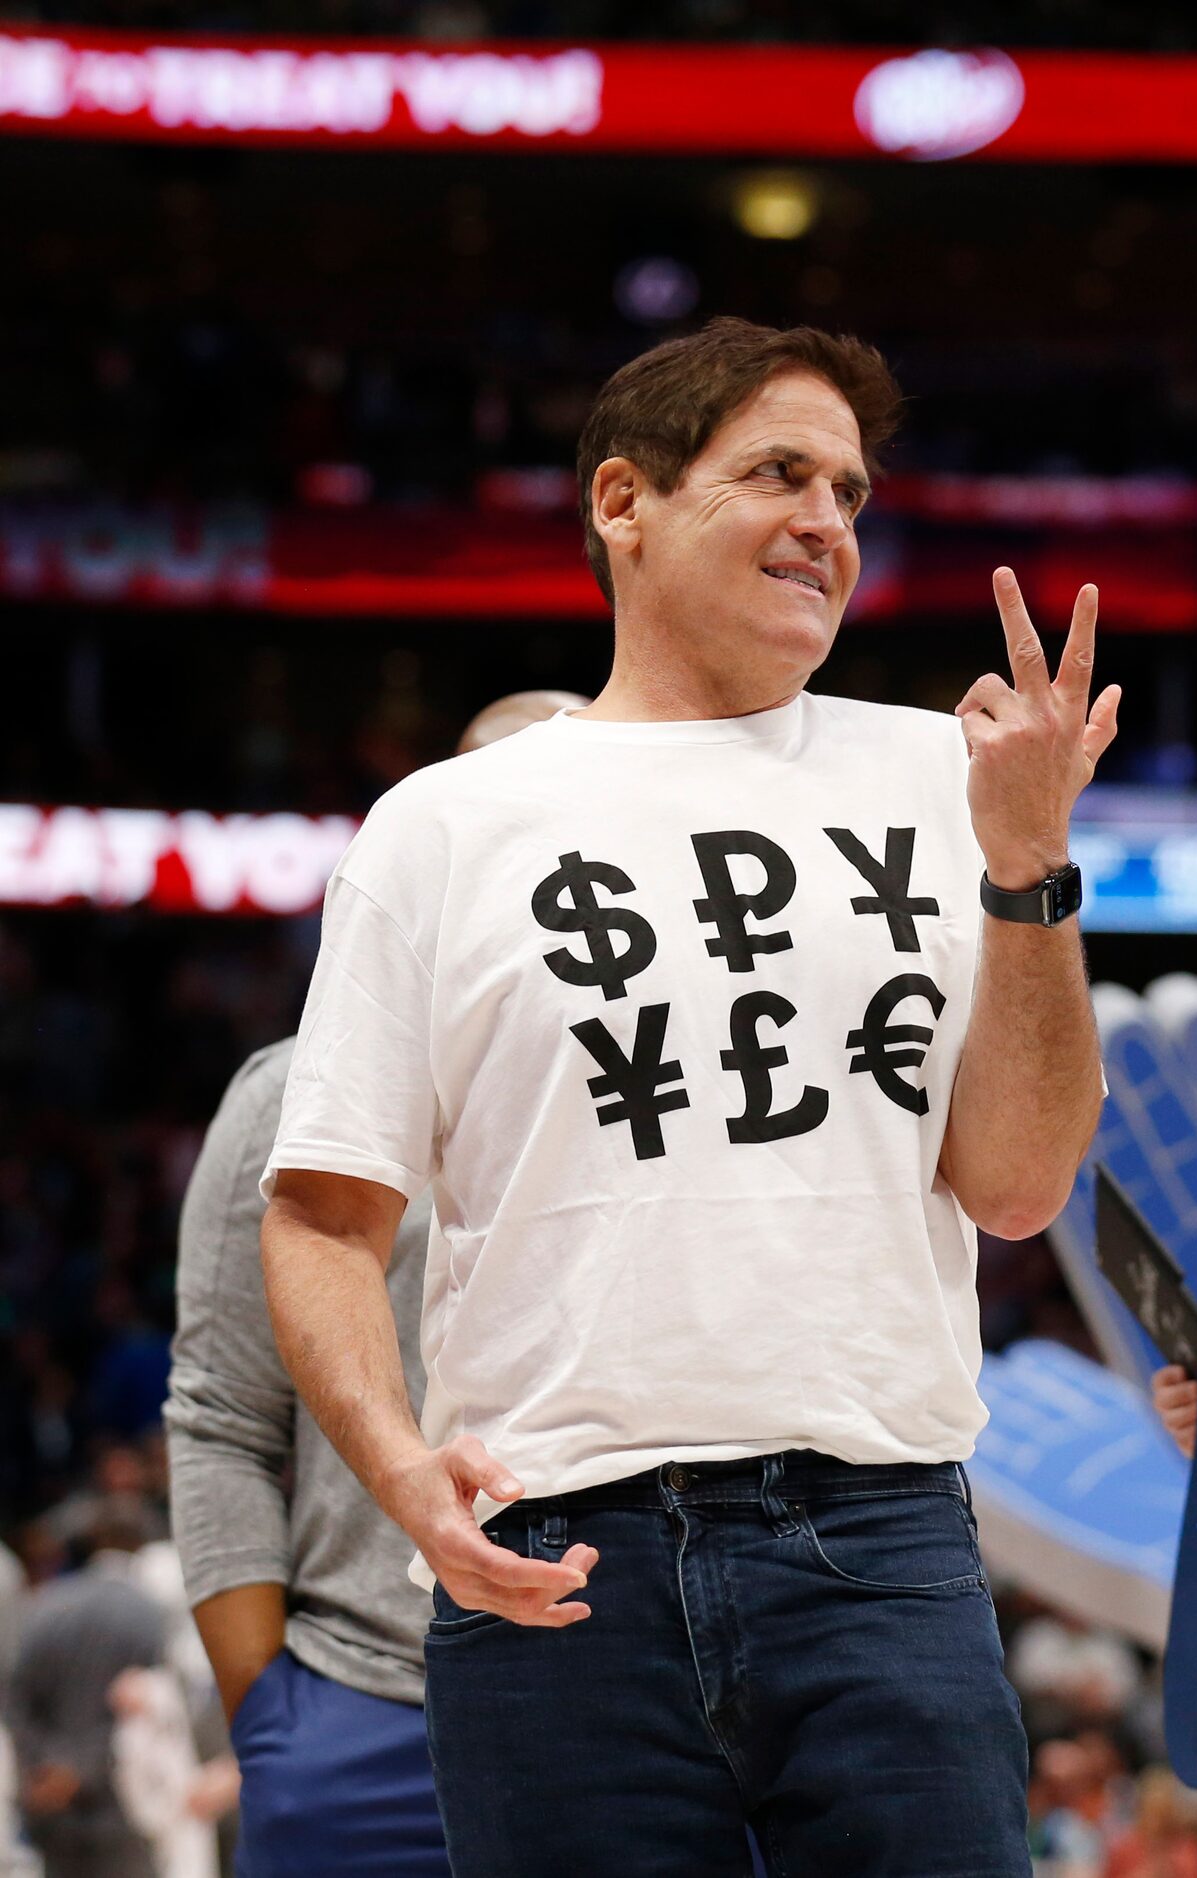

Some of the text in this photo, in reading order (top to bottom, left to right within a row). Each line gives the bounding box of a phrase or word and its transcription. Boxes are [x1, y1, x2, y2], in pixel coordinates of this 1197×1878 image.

[148, 47, 392, 132] TREAT
[531, 850, 657, 1001] $
[568, 973, 947, 1161] ¥ £ €
